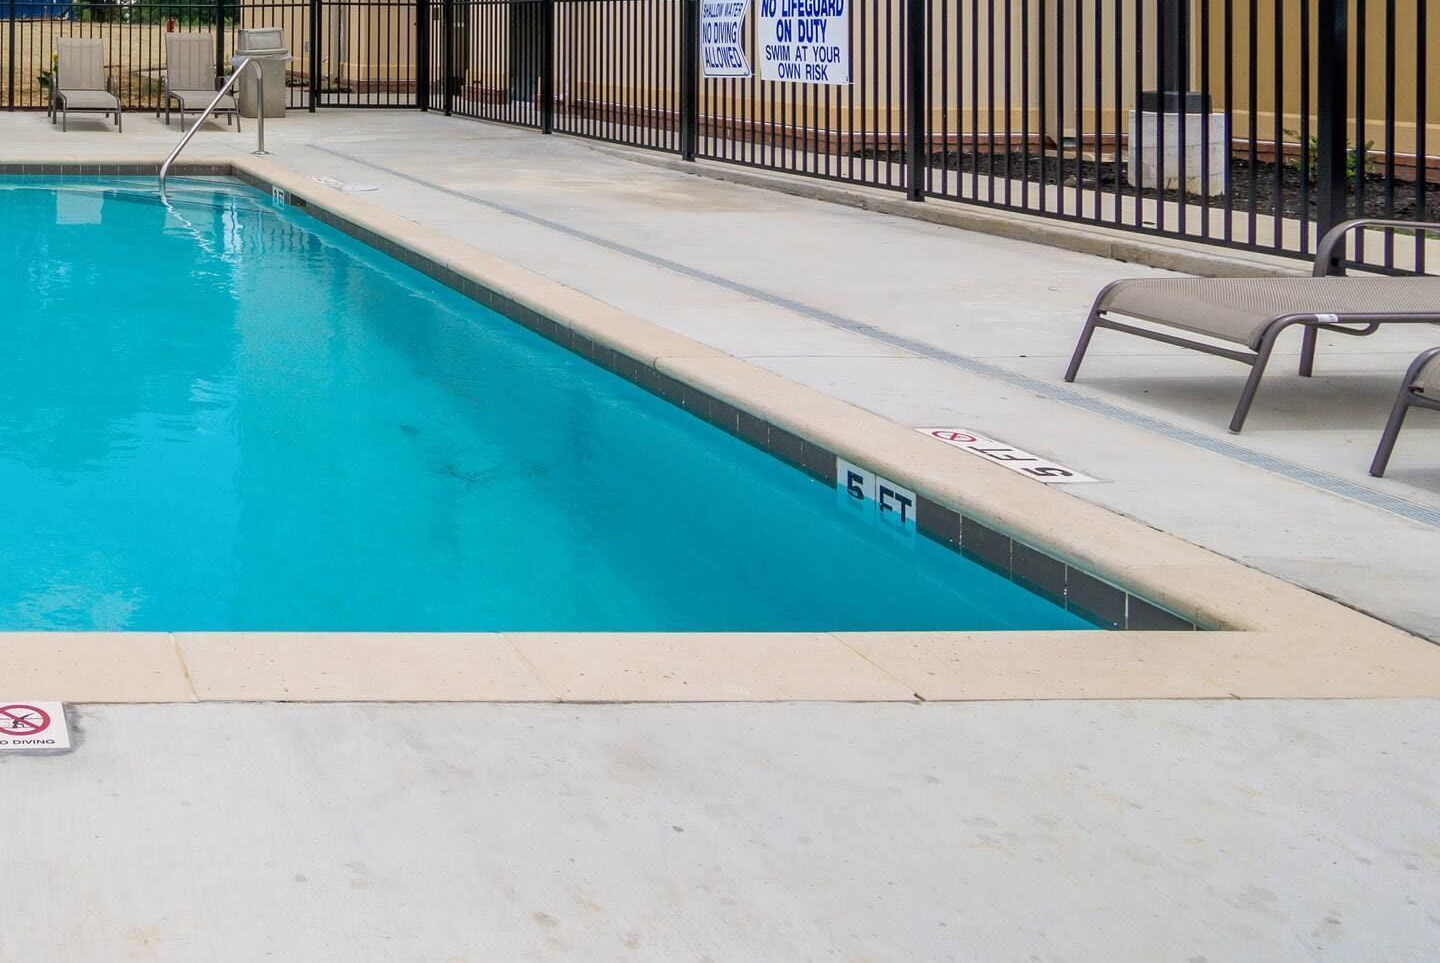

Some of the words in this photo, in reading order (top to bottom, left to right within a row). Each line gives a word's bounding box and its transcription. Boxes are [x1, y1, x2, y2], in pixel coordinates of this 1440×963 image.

[703, 3, 723, 18] SHALLOW
[724, 2, 744, 17] WATER
[702, 22, 713, 44] NO
[713, 21, 737, 44] DIVING
[776, 19, 792, 43] ON
[798, 19, 827, 43] DUTY
[704, 47, 742, 68] ALLOWED
[765, 45, 791, 62] SWIM
[795, 46, 808, 62] AT
[812, 46, 840, 63] YOUR
[778, 63, 800, 79] OWN
[806, 64, 828, 81] RISK
[967, 446, 1038, 461] FT
[1020, 467, 1074, 477] 5
[847, 470, 864, 501] 5
[879, 484, 912, 524] FT
